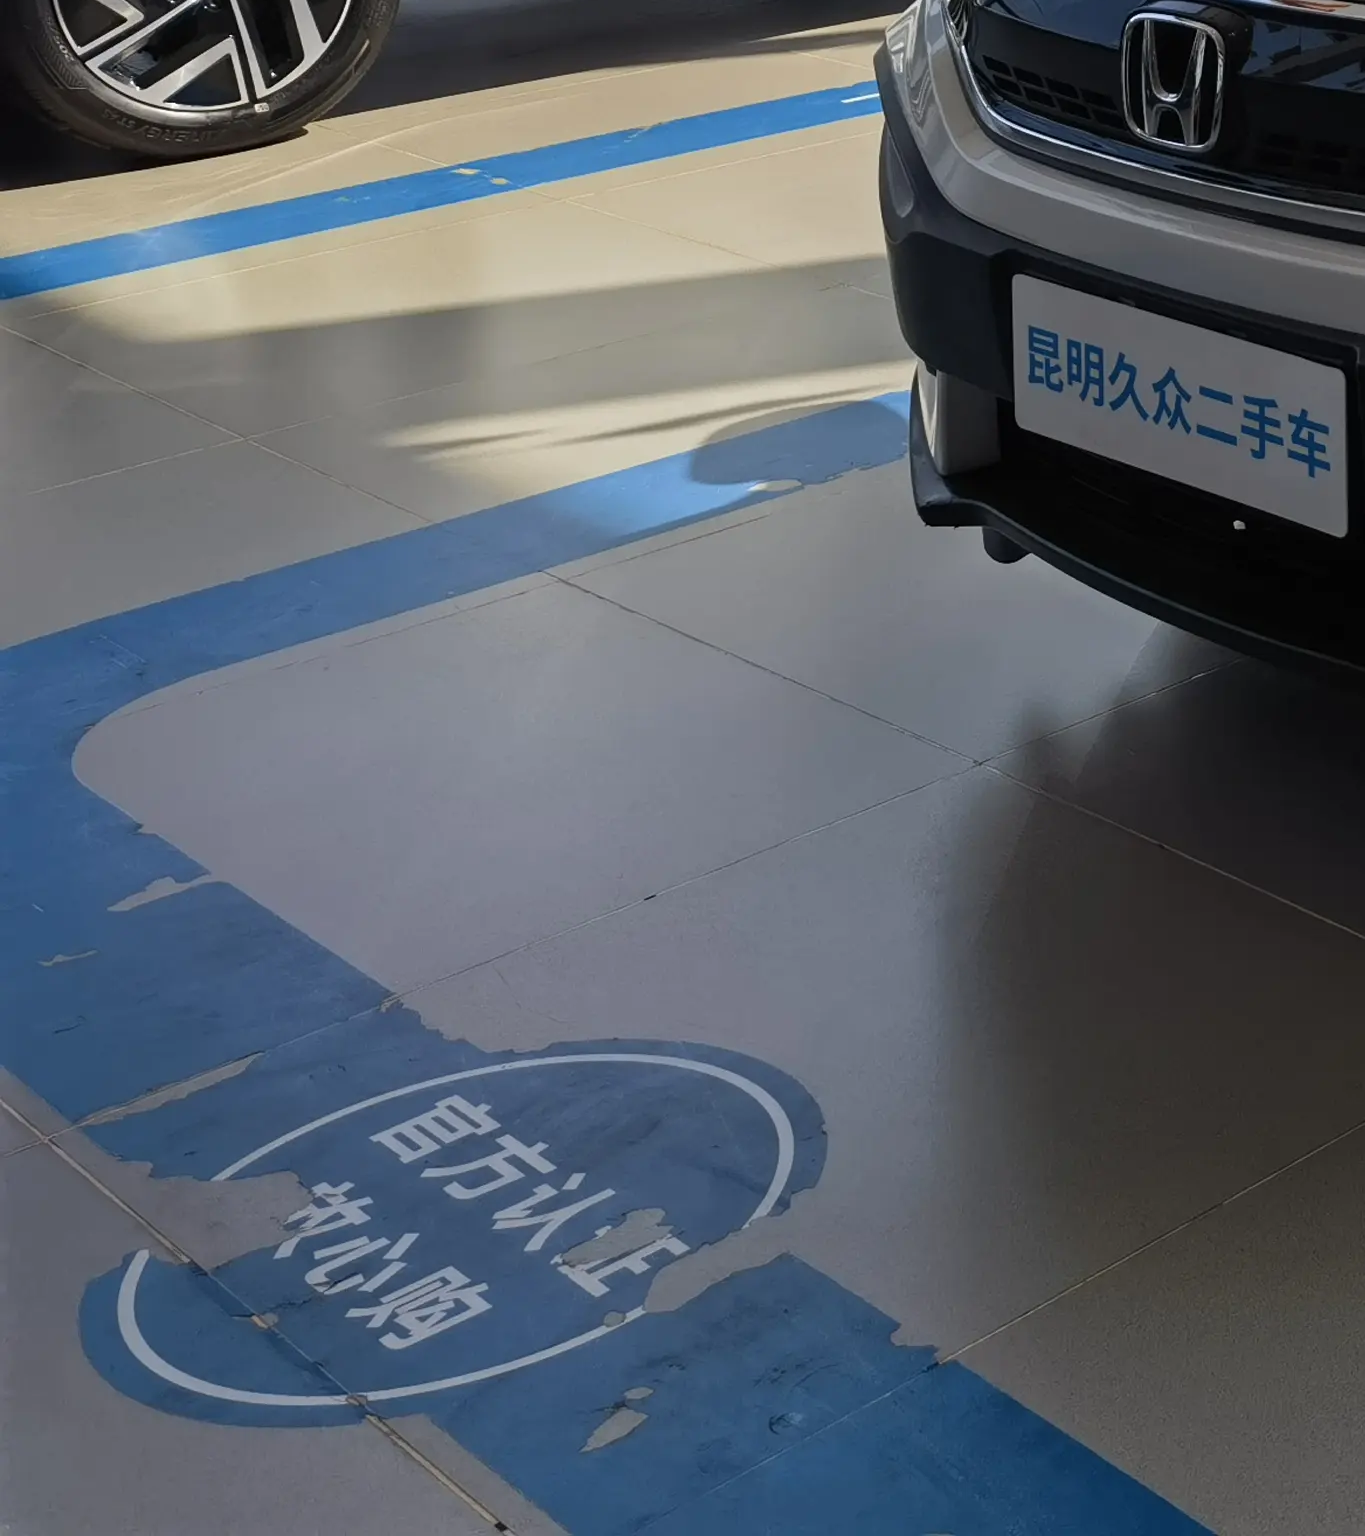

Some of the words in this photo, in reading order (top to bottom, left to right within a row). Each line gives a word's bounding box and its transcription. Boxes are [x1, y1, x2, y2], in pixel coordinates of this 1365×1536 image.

[1027, 325, 1332, 478] 昆明久众二手车
